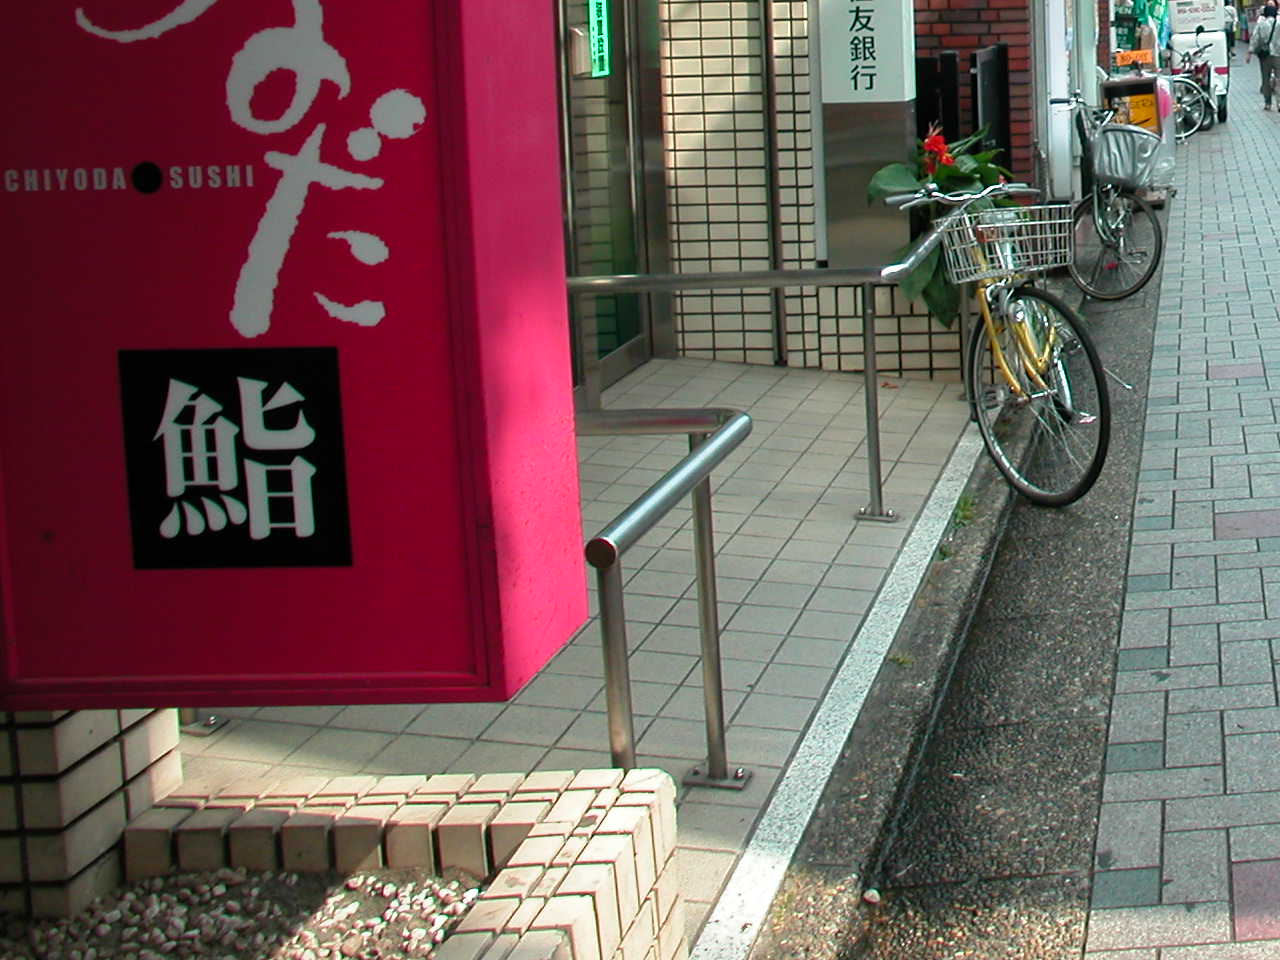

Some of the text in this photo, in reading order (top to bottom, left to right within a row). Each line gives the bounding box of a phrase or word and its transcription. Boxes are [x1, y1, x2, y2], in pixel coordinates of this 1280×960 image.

[4, 164, 256, 193] CHIYODA SUSHI
[153, 375, 317, 541] 鮨
